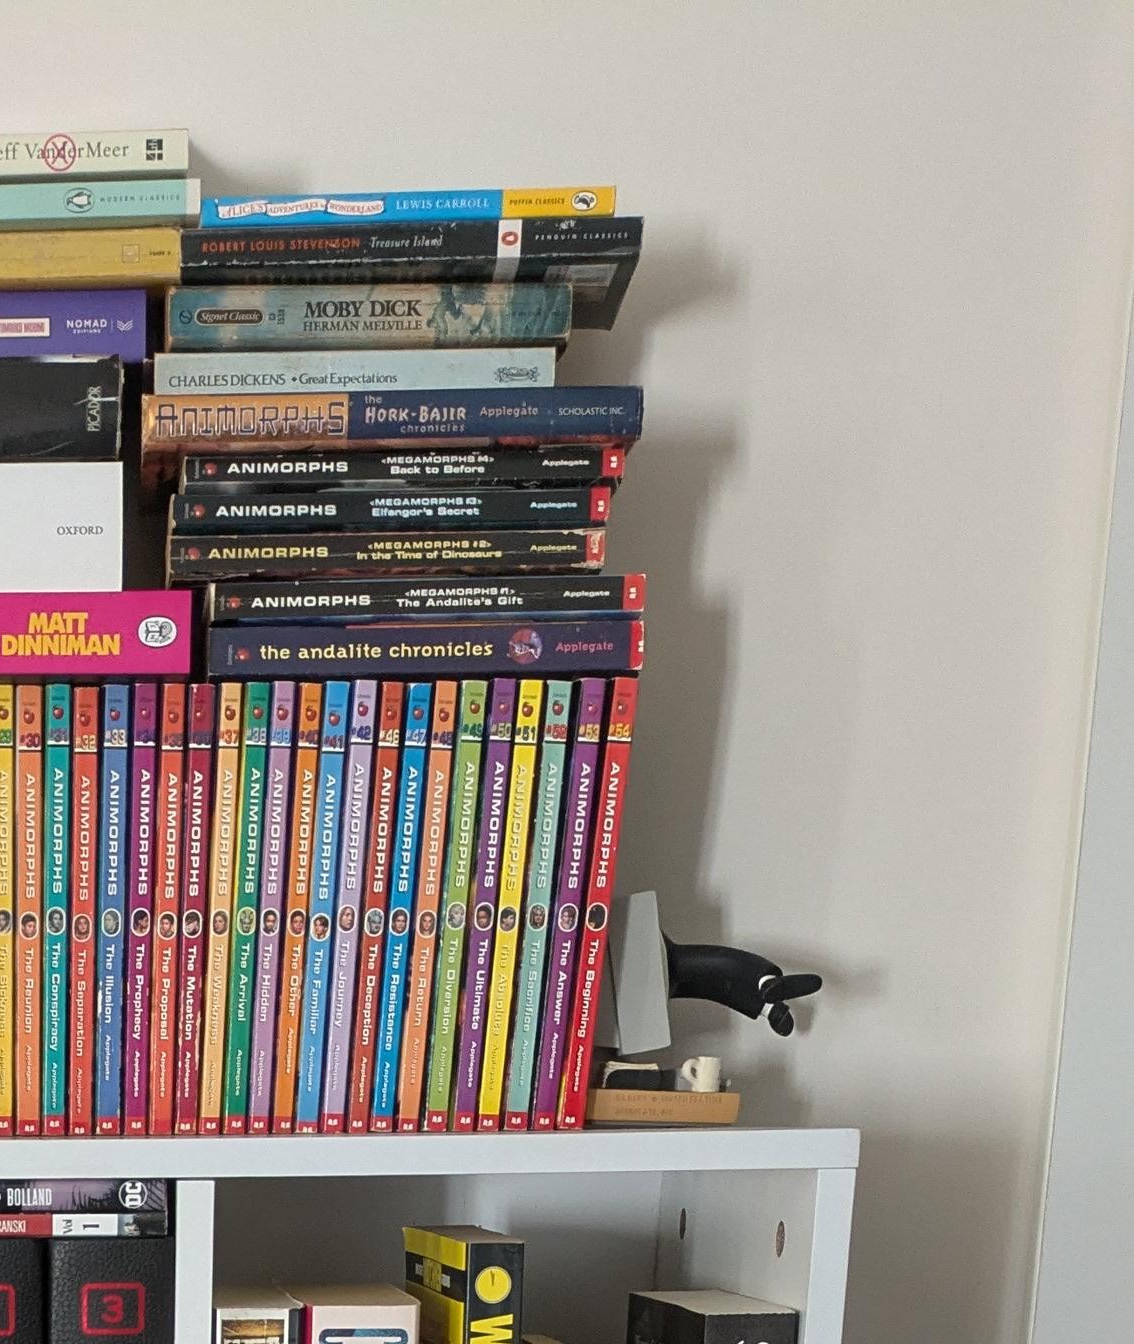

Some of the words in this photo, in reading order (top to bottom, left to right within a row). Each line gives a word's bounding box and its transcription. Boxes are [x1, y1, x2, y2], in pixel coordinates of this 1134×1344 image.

[395, 198, 431, 210] LEWIS
[434, 195, 490, 209] CARROLL
[370, 236, 410, 248] Treasure
[410, 234, 443, 248] Island
[304, 300, 364, 320] MOBY
[369, 300, 423, 319] DICK
[67, 319, 108, 329] NOMAD
[303, 319, 359, 333] HERMAN
[363, 318, 423, 331] MELVILLE
[169, 374, 229, 388] CHARLES
[229, 372, 286, 387] DICKENS
[329, 371, 398, 386] Expectations
[227, 461, 349, 475] ANIMORPHS
[56, 525, 103, 536] OXFORD
[28, 613, 88, 633] MATT
[1, 634, 120, 657] DINNIMAN
[260, 644, 291, 660] the
[297, 642, 382, 660] andalite
[389, 640, 493, 659] chronicles
[555, 640, 613, 654] Applegate
[596, 762, 620, 889] ANIMORPHS
[237, 976, 246, 1021] Arrival
[577, 972, 594, 1038] Beginning
